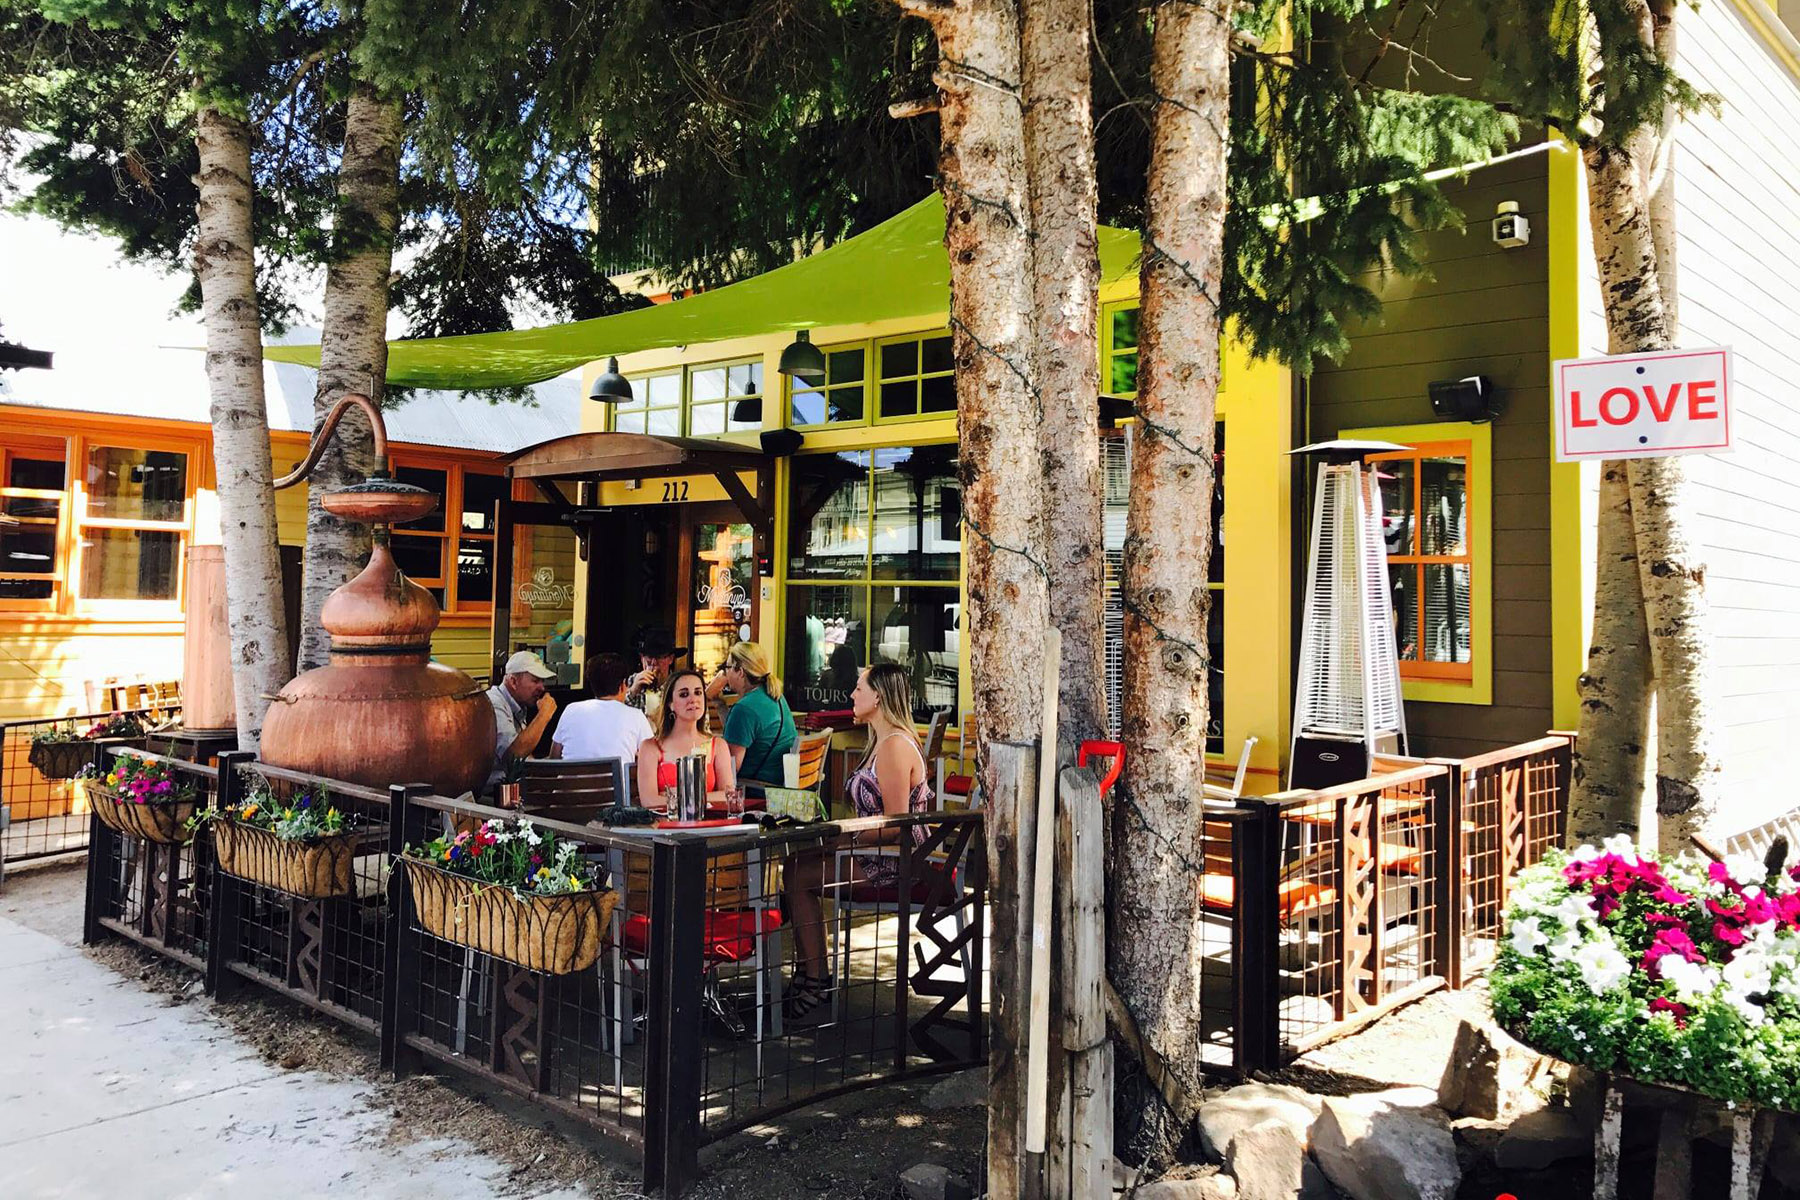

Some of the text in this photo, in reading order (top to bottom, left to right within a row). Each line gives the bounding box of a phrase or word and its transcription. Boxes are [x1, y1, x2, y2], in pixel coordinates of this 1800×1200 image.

[1571, 380, 1718, 428] LOVE
[662, 481, 689, 501] 212
[697, 585, 746, 613] Manya
[804, 687, 849, 703] TOURS
